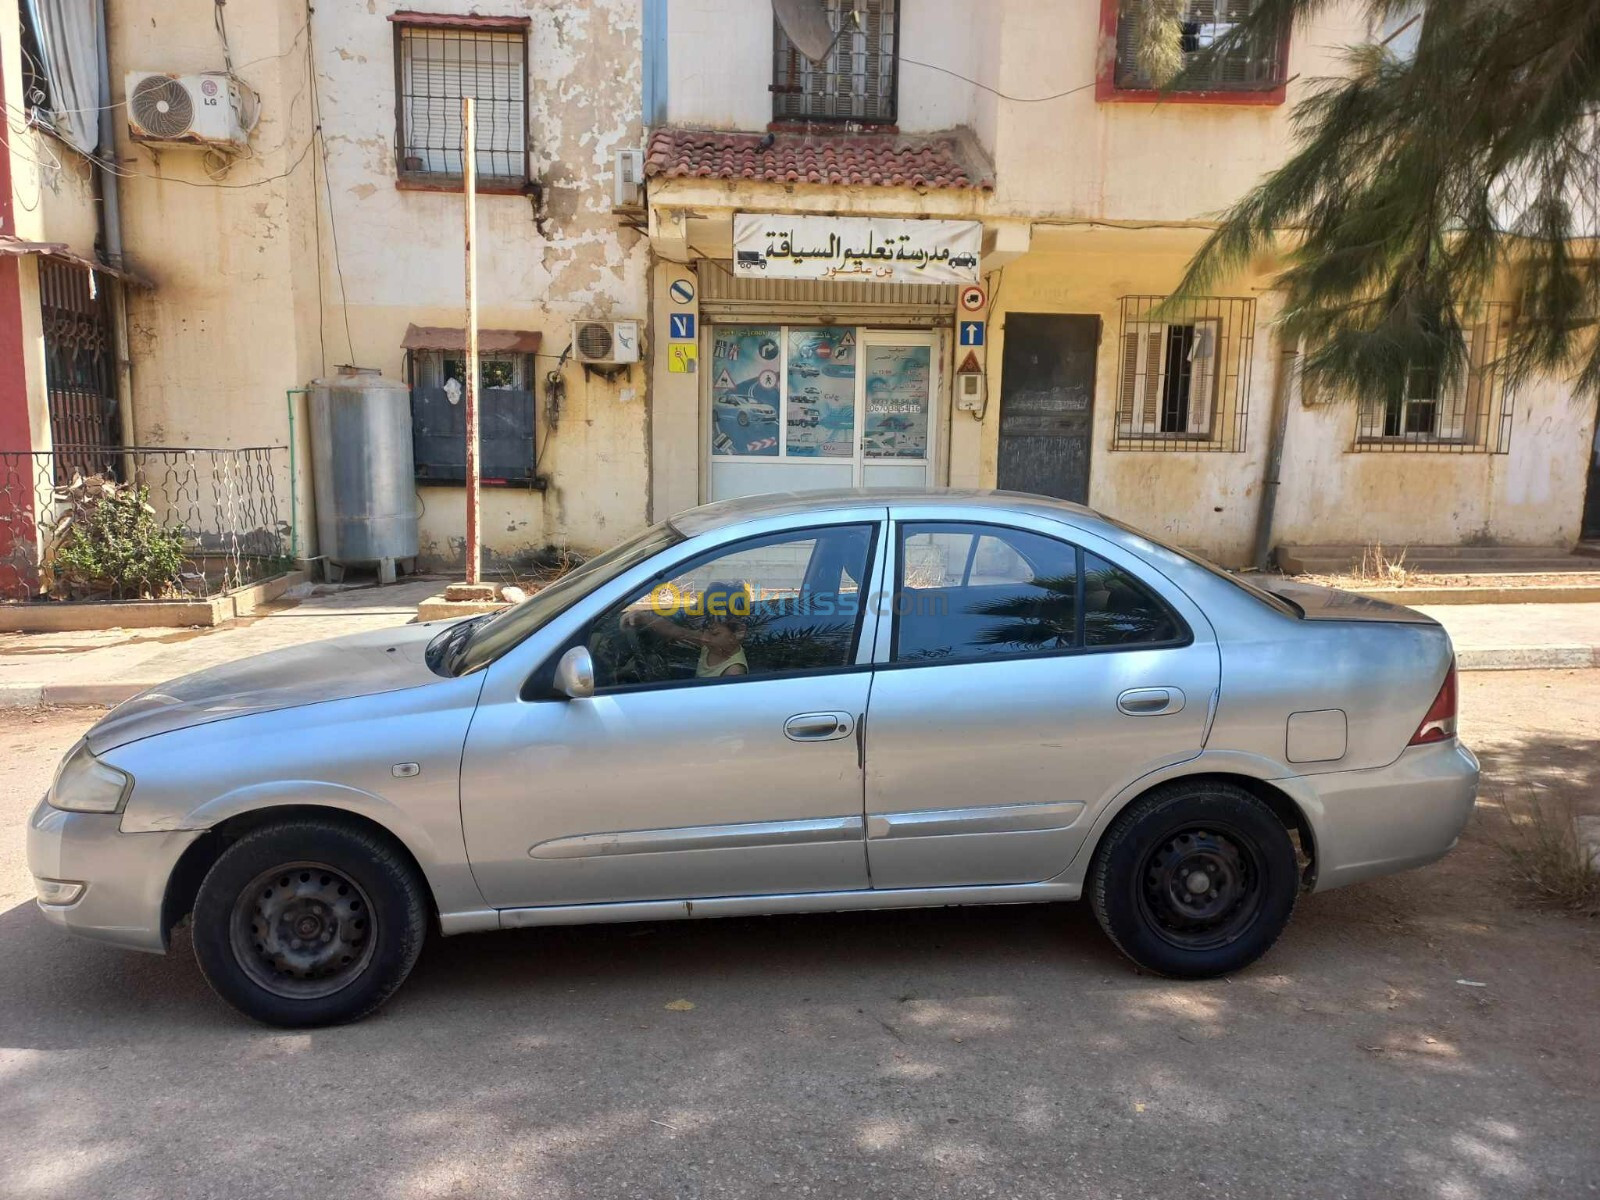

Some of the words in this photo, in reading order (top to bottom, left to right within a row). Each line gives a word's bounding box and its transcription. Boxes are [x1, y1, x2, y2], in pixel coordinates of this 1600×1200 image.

[204, 97, 217, 106] LG
[766, 229, 841, 264] السياقة
[839, 230, 896, 270] تعليم
[896, 235, 950, 269] مدرسة
[875, 268, 893, 277] بن
